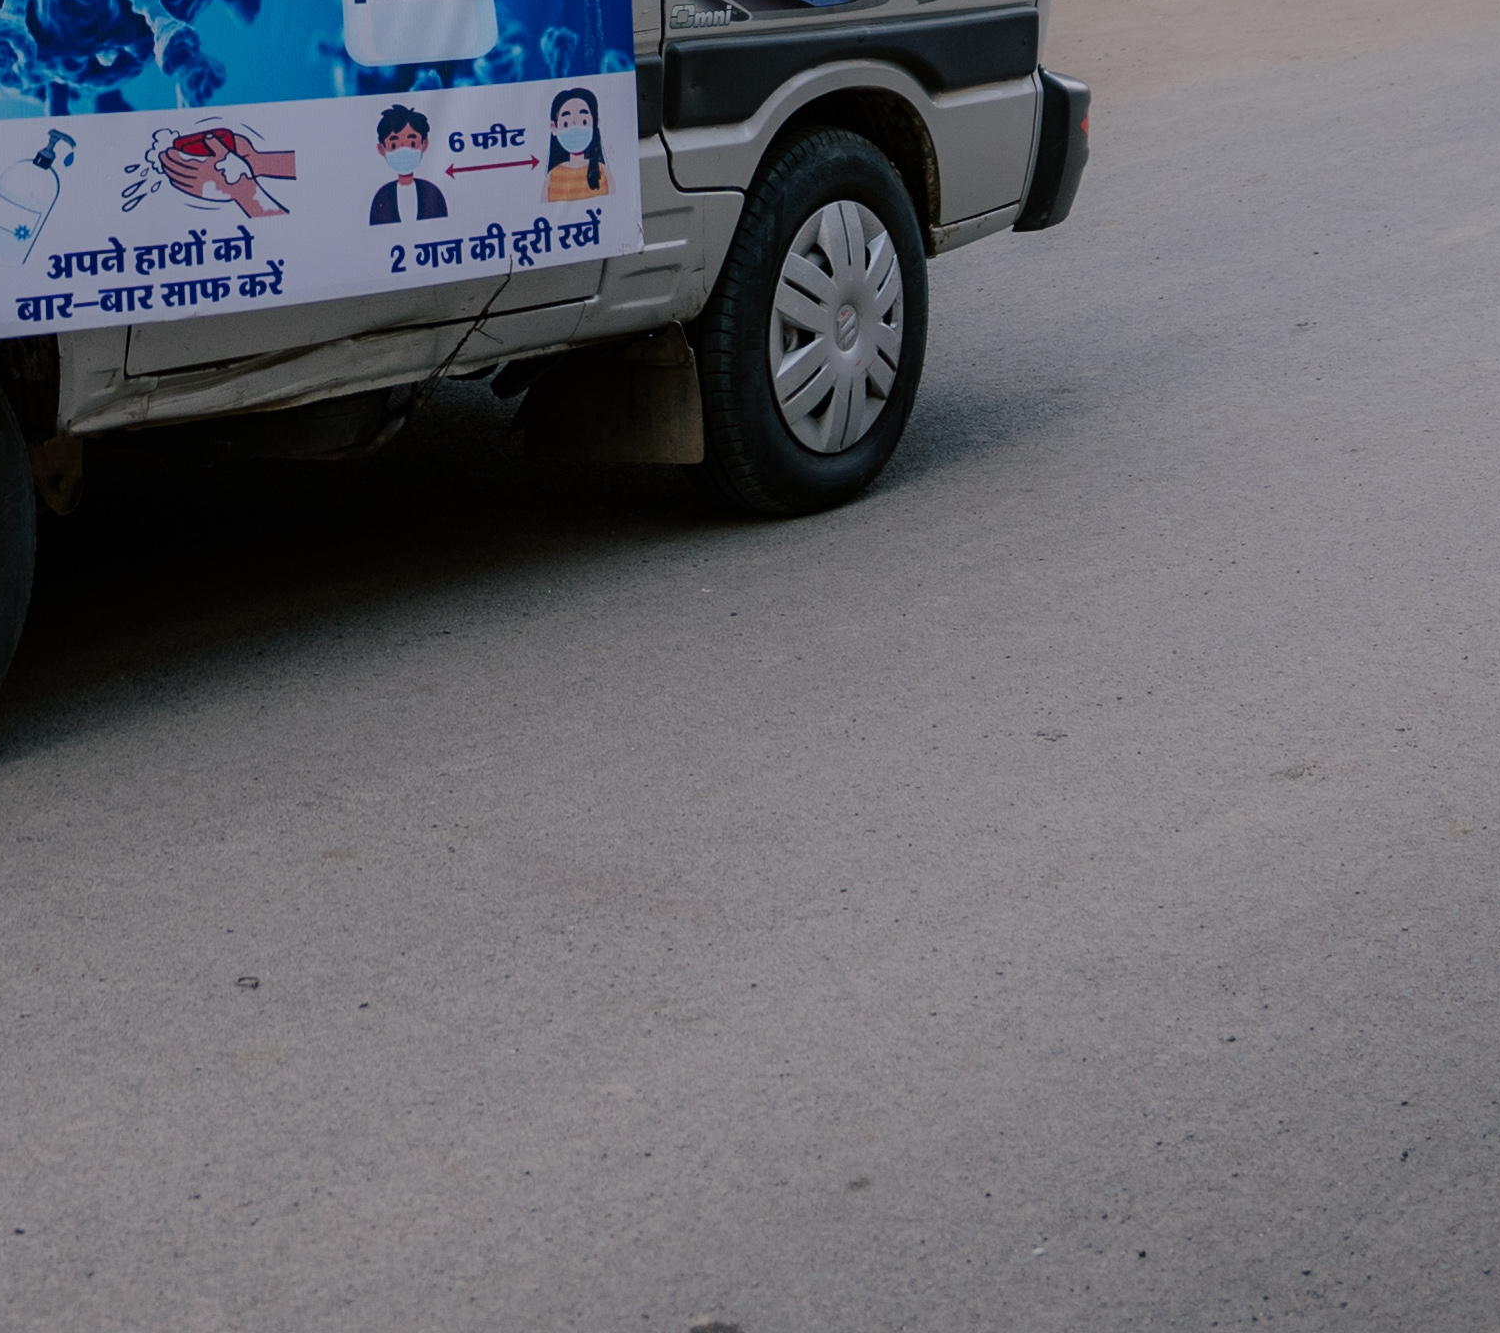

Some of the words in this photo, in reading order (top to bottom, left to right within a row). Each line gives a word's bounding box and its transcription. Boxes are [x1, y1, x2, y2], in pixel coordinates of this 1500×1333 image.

[449, 132, 465, 153] 6
[471, 127, 526, 151] फीट
[46, 237, 125, 281] अपने
[135, 229, 207, 276] हाथों
[212, 226, 255, 263] को
[391, 247, 407, 274] 2
[417, 238, 464, 270] गज
[470, 224, 507, 263] की
[511, 221, 553, 267] दूरी
[558, 210, 602, 251] रखें
[161, 274, 231, 308] साफ
[238, 260, 285, 299] करें
